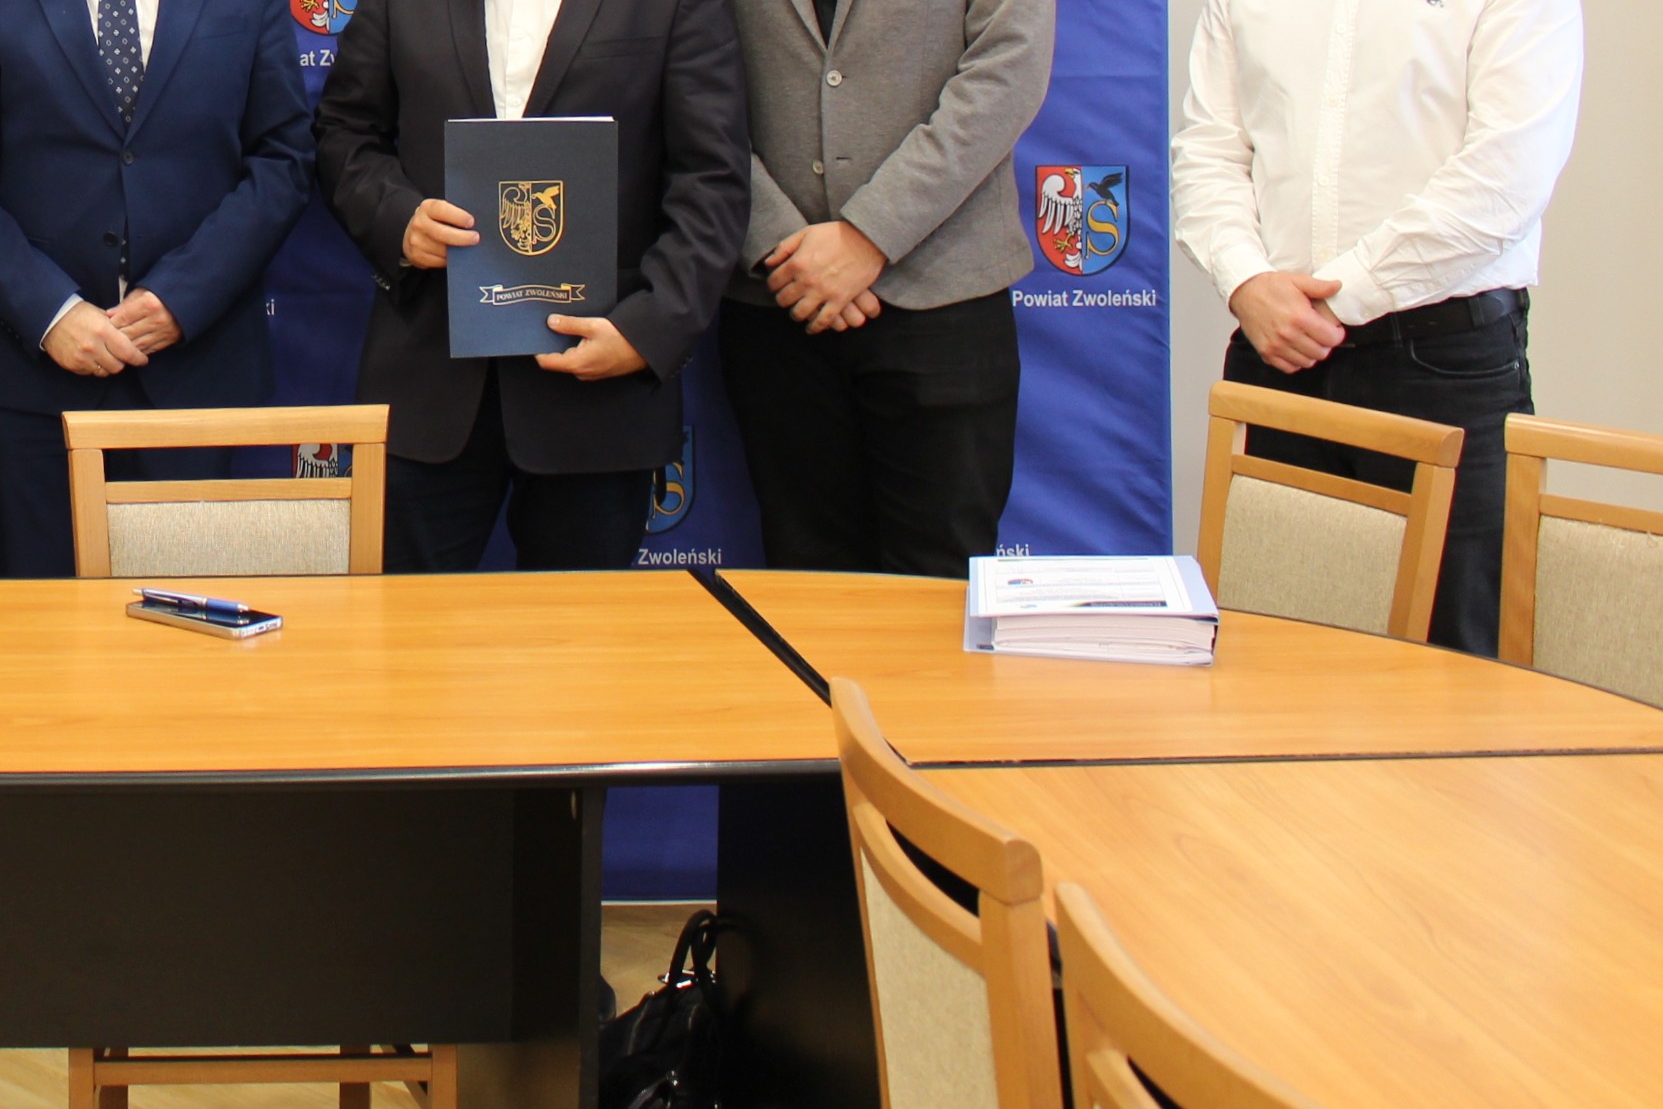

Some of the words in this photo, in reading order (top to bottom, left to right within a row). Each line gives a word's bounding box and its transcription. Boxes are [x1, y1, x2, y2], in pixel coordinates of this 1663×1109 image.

[496, 291, 523, 301] POWIAT
[1012, 290, 1069, 307] Powiat
[1071, 289, 1157, 307] Zwoleński
[638, 548, 723, 565] Zwoleński
